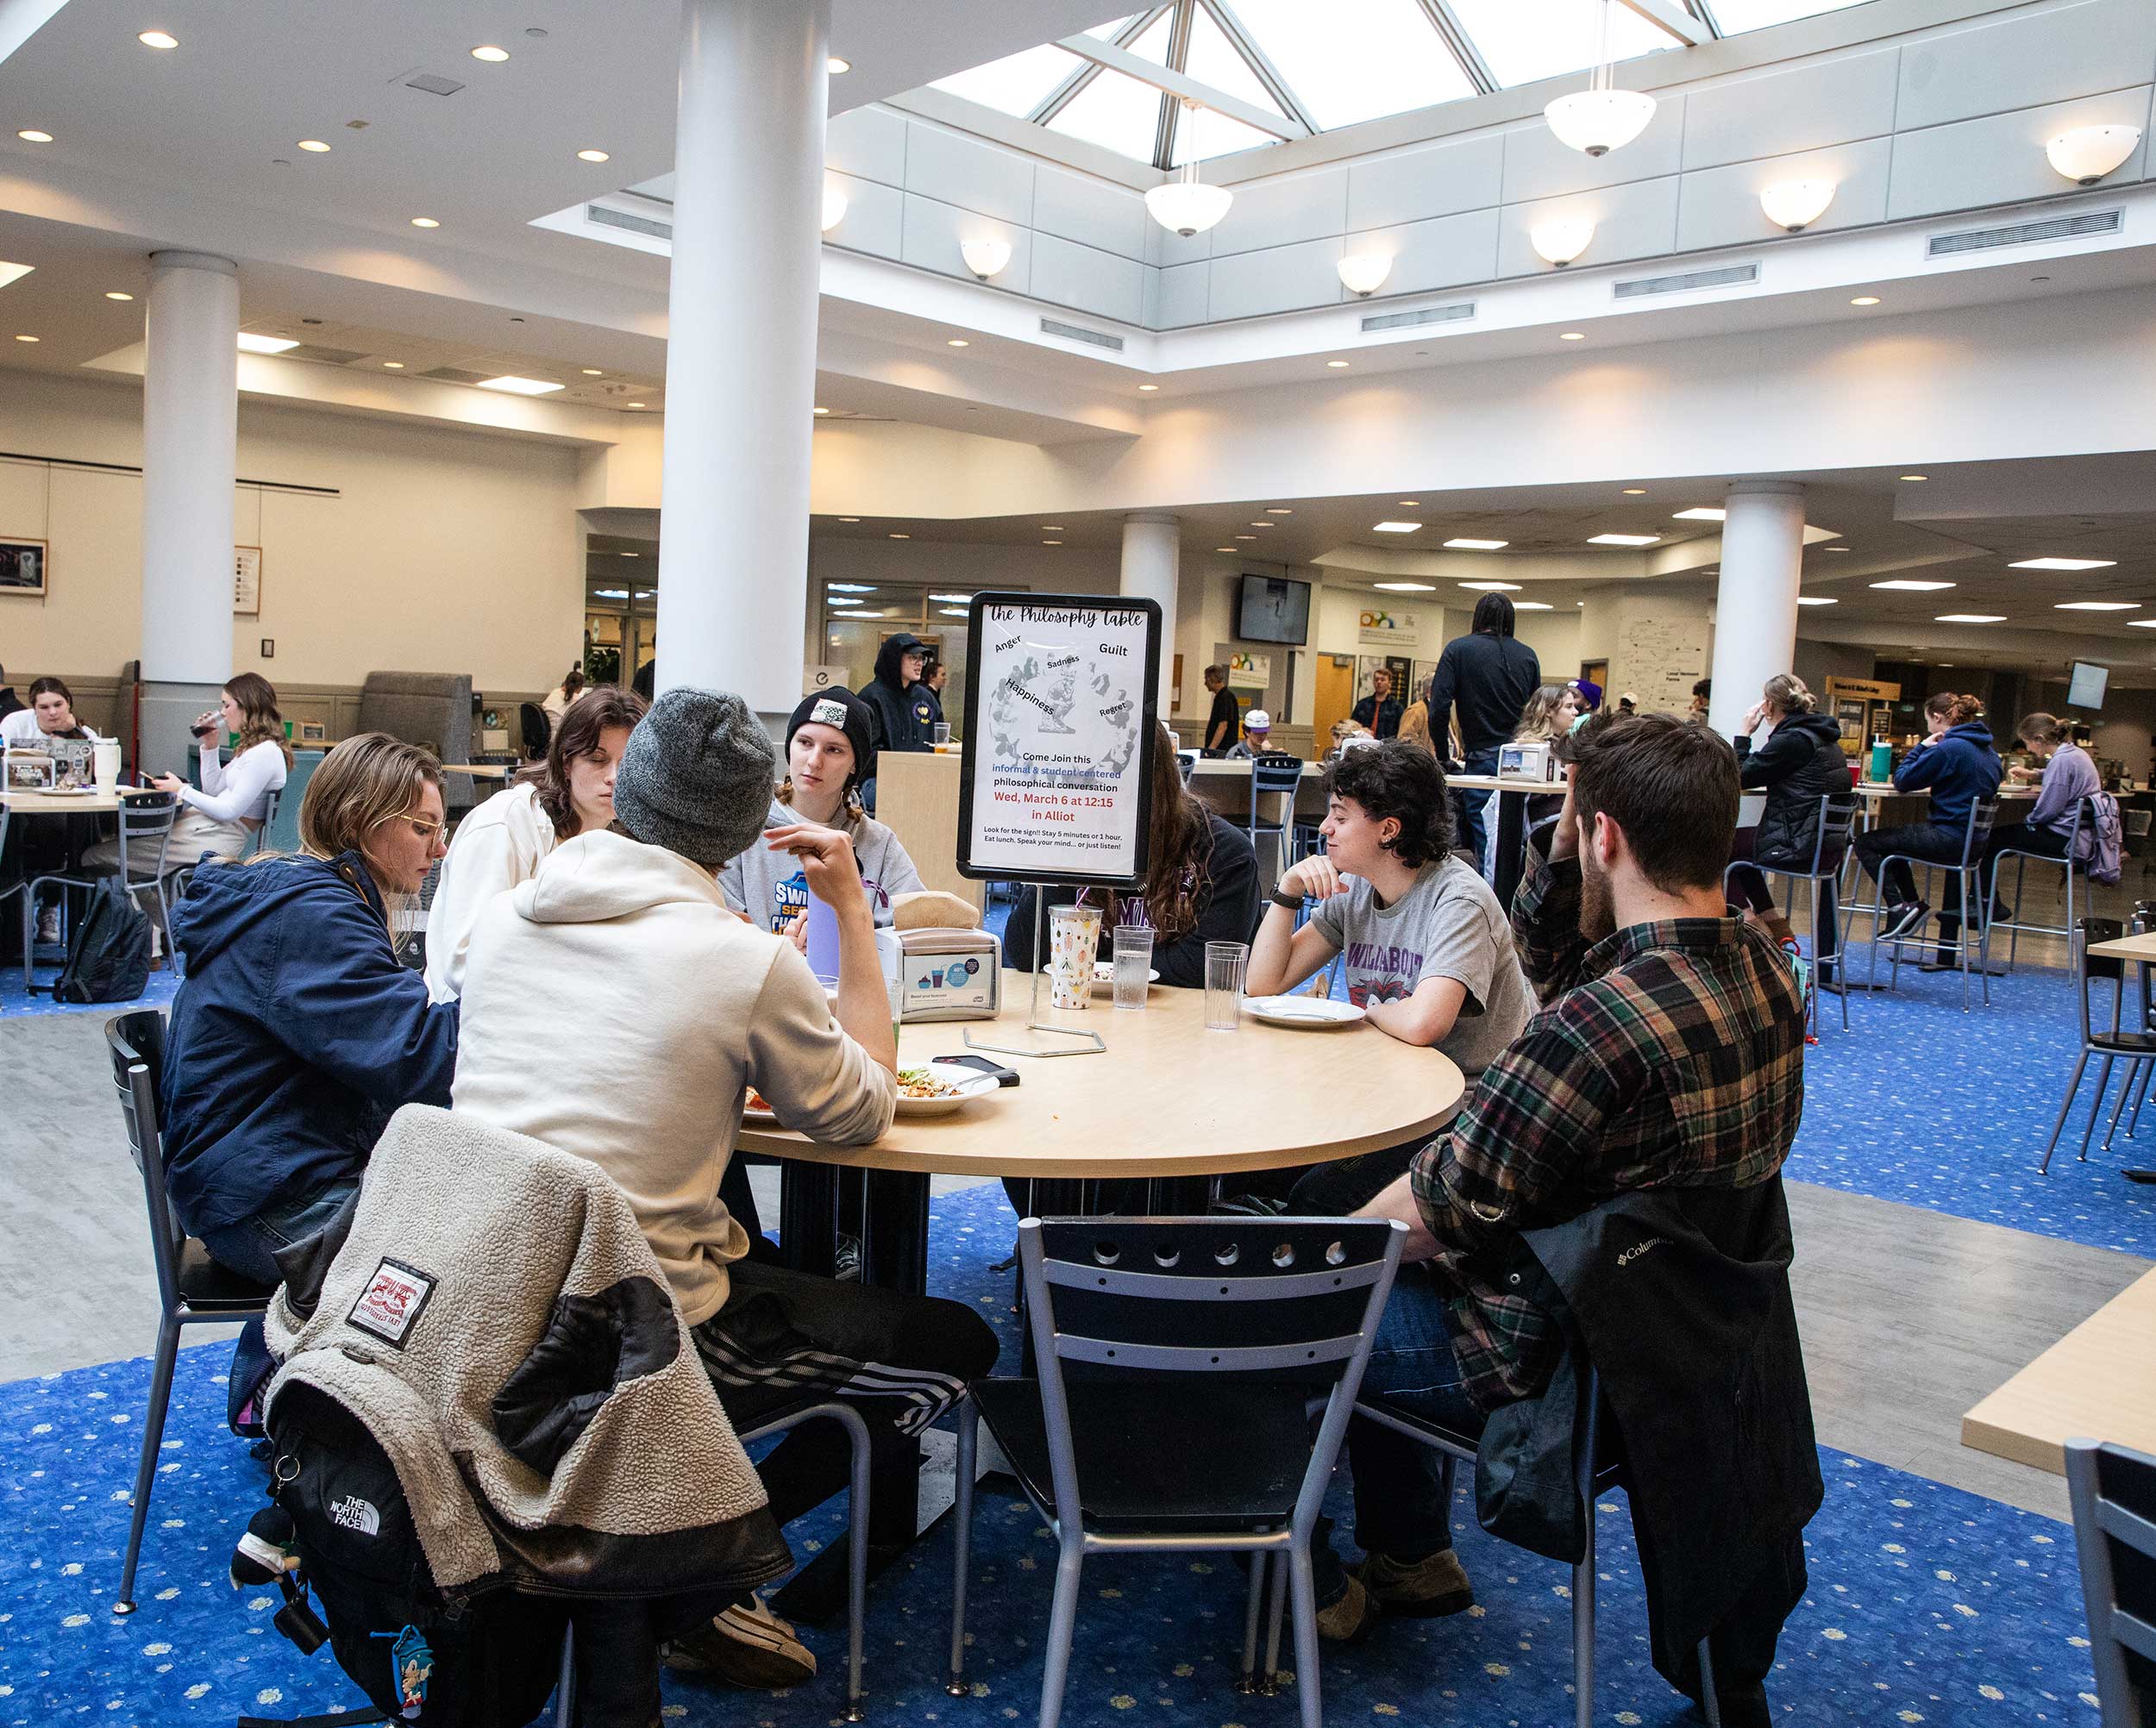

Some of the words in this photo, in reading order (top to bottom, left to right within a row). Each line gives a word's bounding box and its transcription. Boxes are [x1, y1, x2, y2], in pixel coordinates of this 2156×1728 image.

[1020, 606, 1097, 628] Philosophy
[1101, 609, 1144, 627] Table
[994, 635, 1022, 653] Anger
[1099, 642, 1128, 657] Guilt
[1047, 654, 1080, 669] Sadness
[1005, 678, 1055, 716] Happiness
[1099, 702, 1126, 717] Regret
[1023, 752, 1050, 761] Come
[1051, 754, 1071, 763] Join
[1074, 754, 1091, 764] this
[992, 764, 1031, 773] informal
[1041, 767, 1077, 777] student
[1079, 768, 1121, 779] centered
[993, 778, 1055, 789] philosophical
[1056, 781, 1118, 792] conversation
[994, 792, 1021, 804] Wed,
[1024, 793, 1058, 805] March
[1061, 795, 1068, 805] 6
[1070, 797, 1081, 806] at
[1085, 797, 1113, 808] 12:15
[1031, 810, 1042, 820] in
[1044, 811, 1075, 822] Alliot
[1017, 837, 1037, 846] Speak
[1042, 830, 1056, 838] Stay
[775, 881, 808, 905] SWI
[1626, 1237, 1673, 1260] Columb
[330, 1500, 363, 1520] NORTH
[346, 1495, 366, 1510] THE
[335, 1513, 361, 1530] FACE
